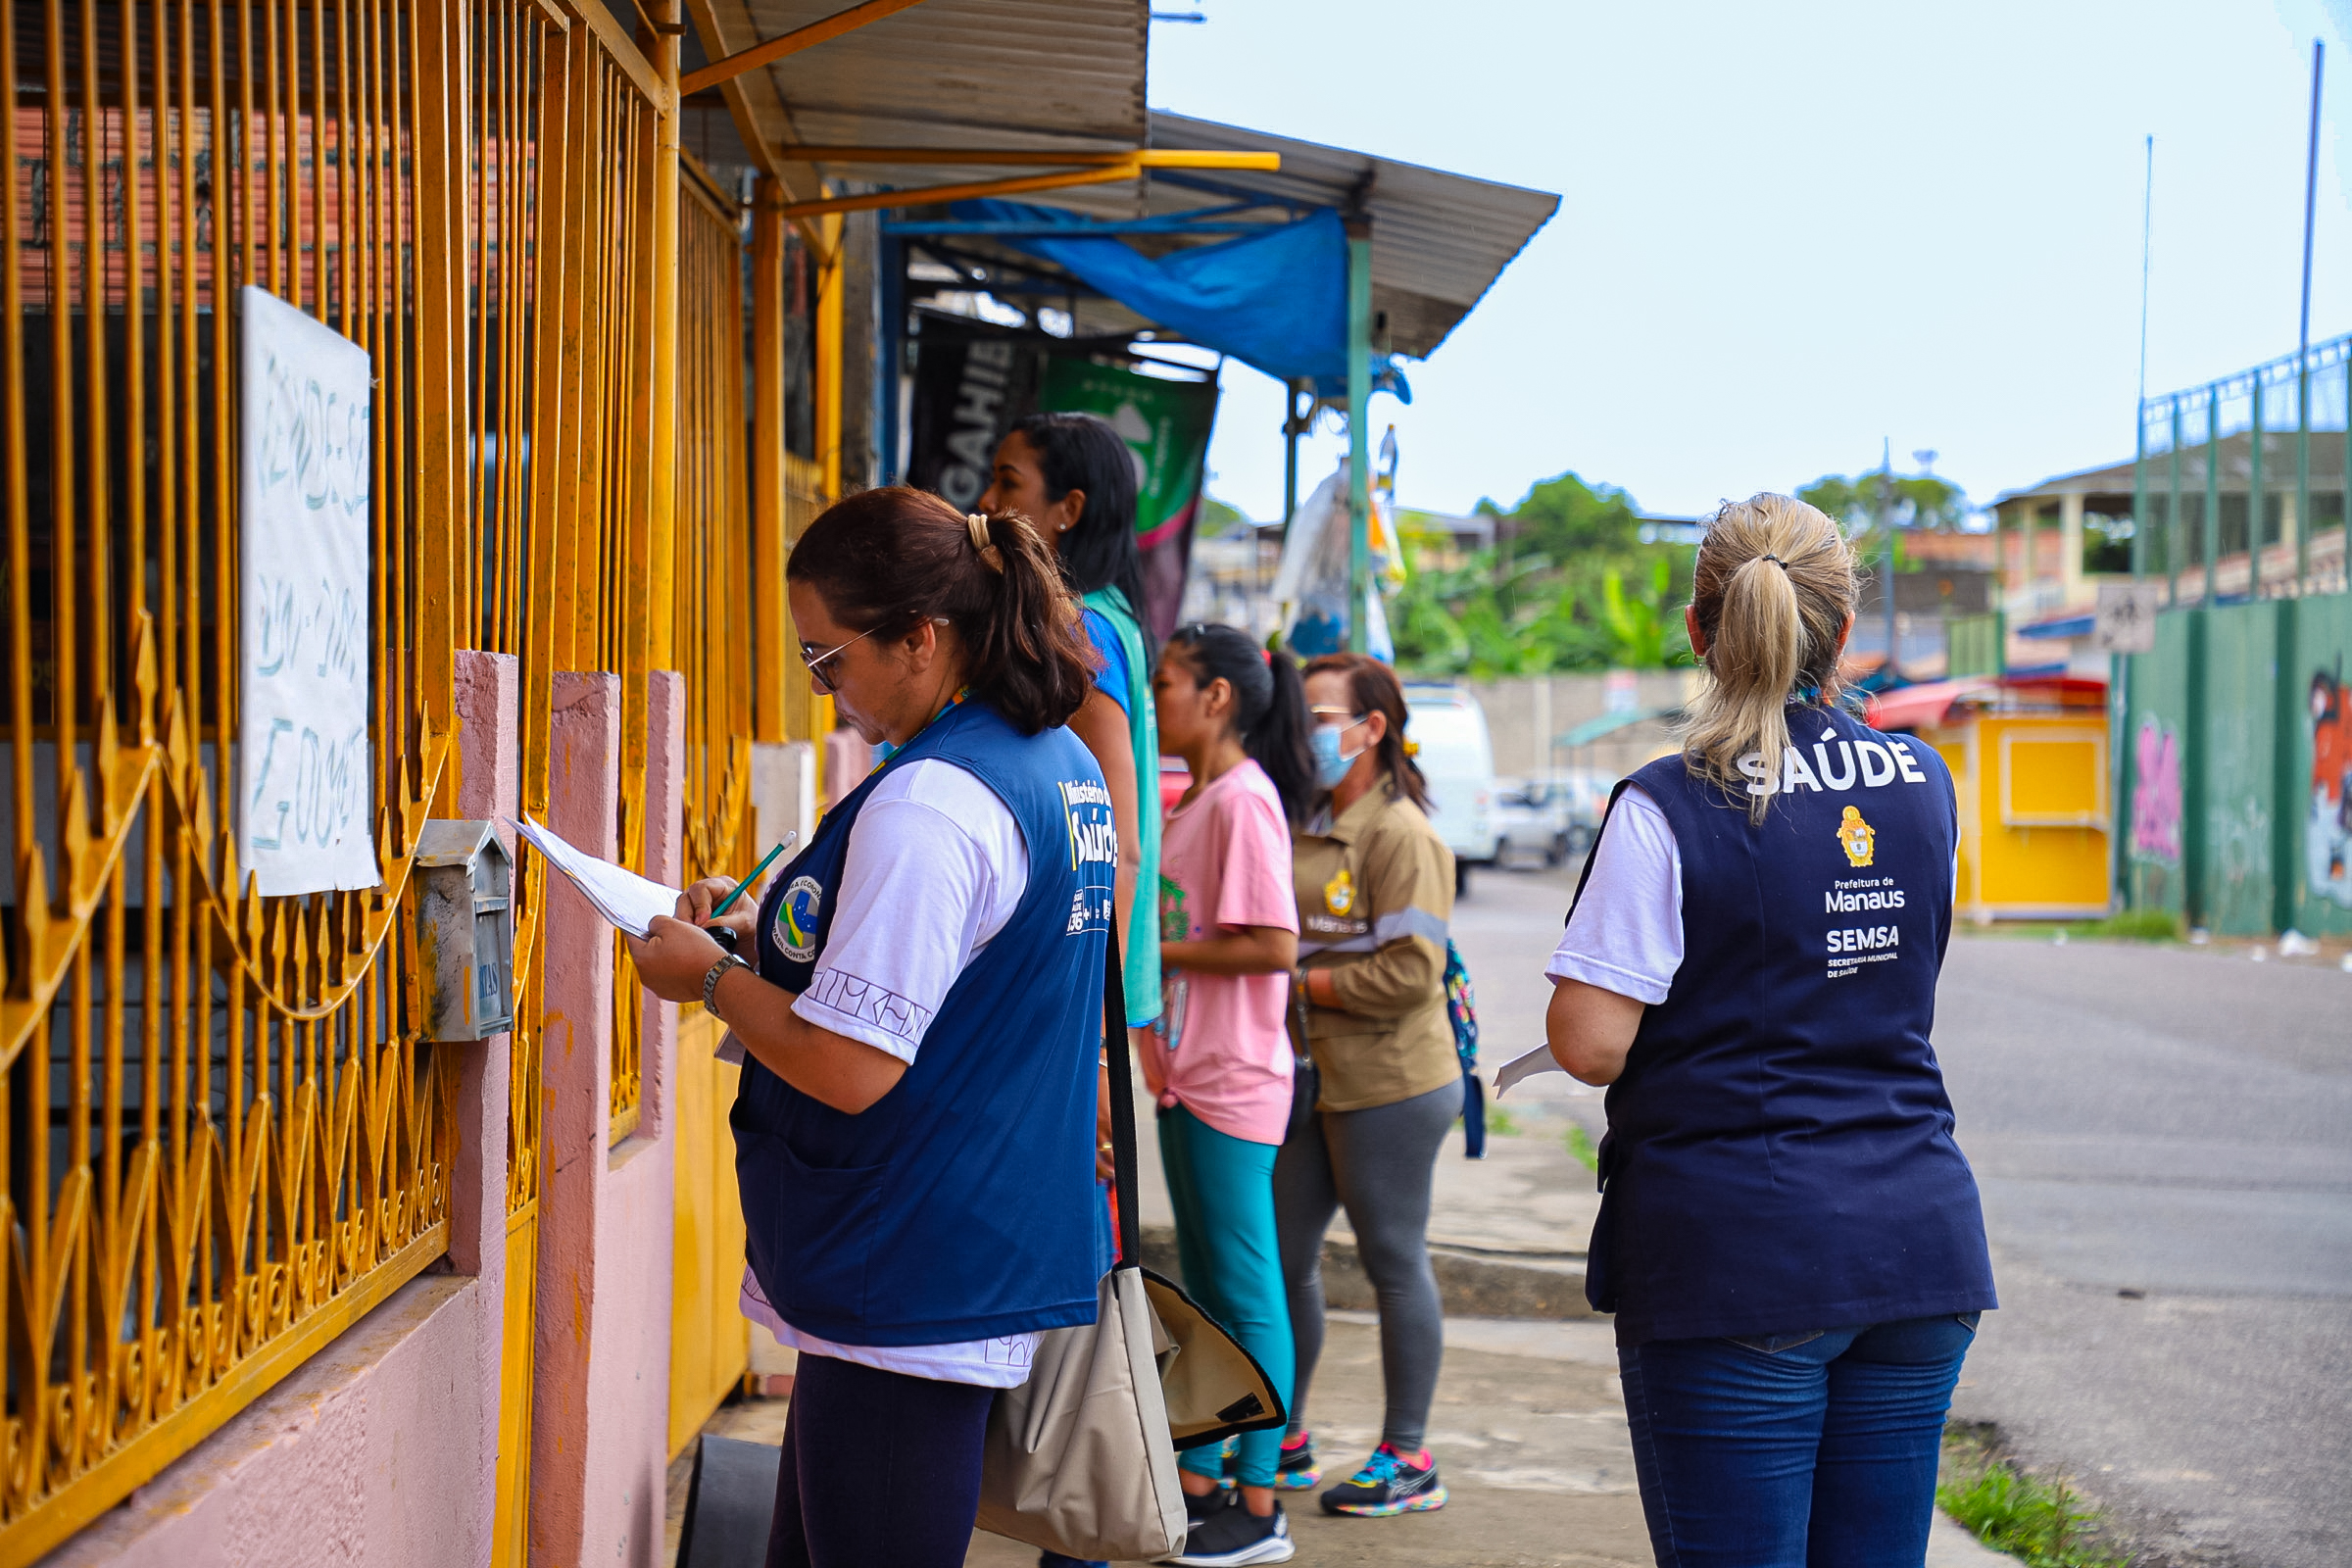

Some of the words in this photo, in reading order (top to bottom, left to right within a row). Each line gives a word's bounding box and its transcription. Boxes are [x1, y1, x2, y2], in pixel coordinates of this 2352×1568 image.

[1737, 727, 1926, 795] SAÚDE
[1835, 878, 1880, 890] Prefeitura
[1883, 876, 1894, 887] de
[1825, 890, 1905, 913] Manaus
[1826, 925, 1899, 953] SEMSA
